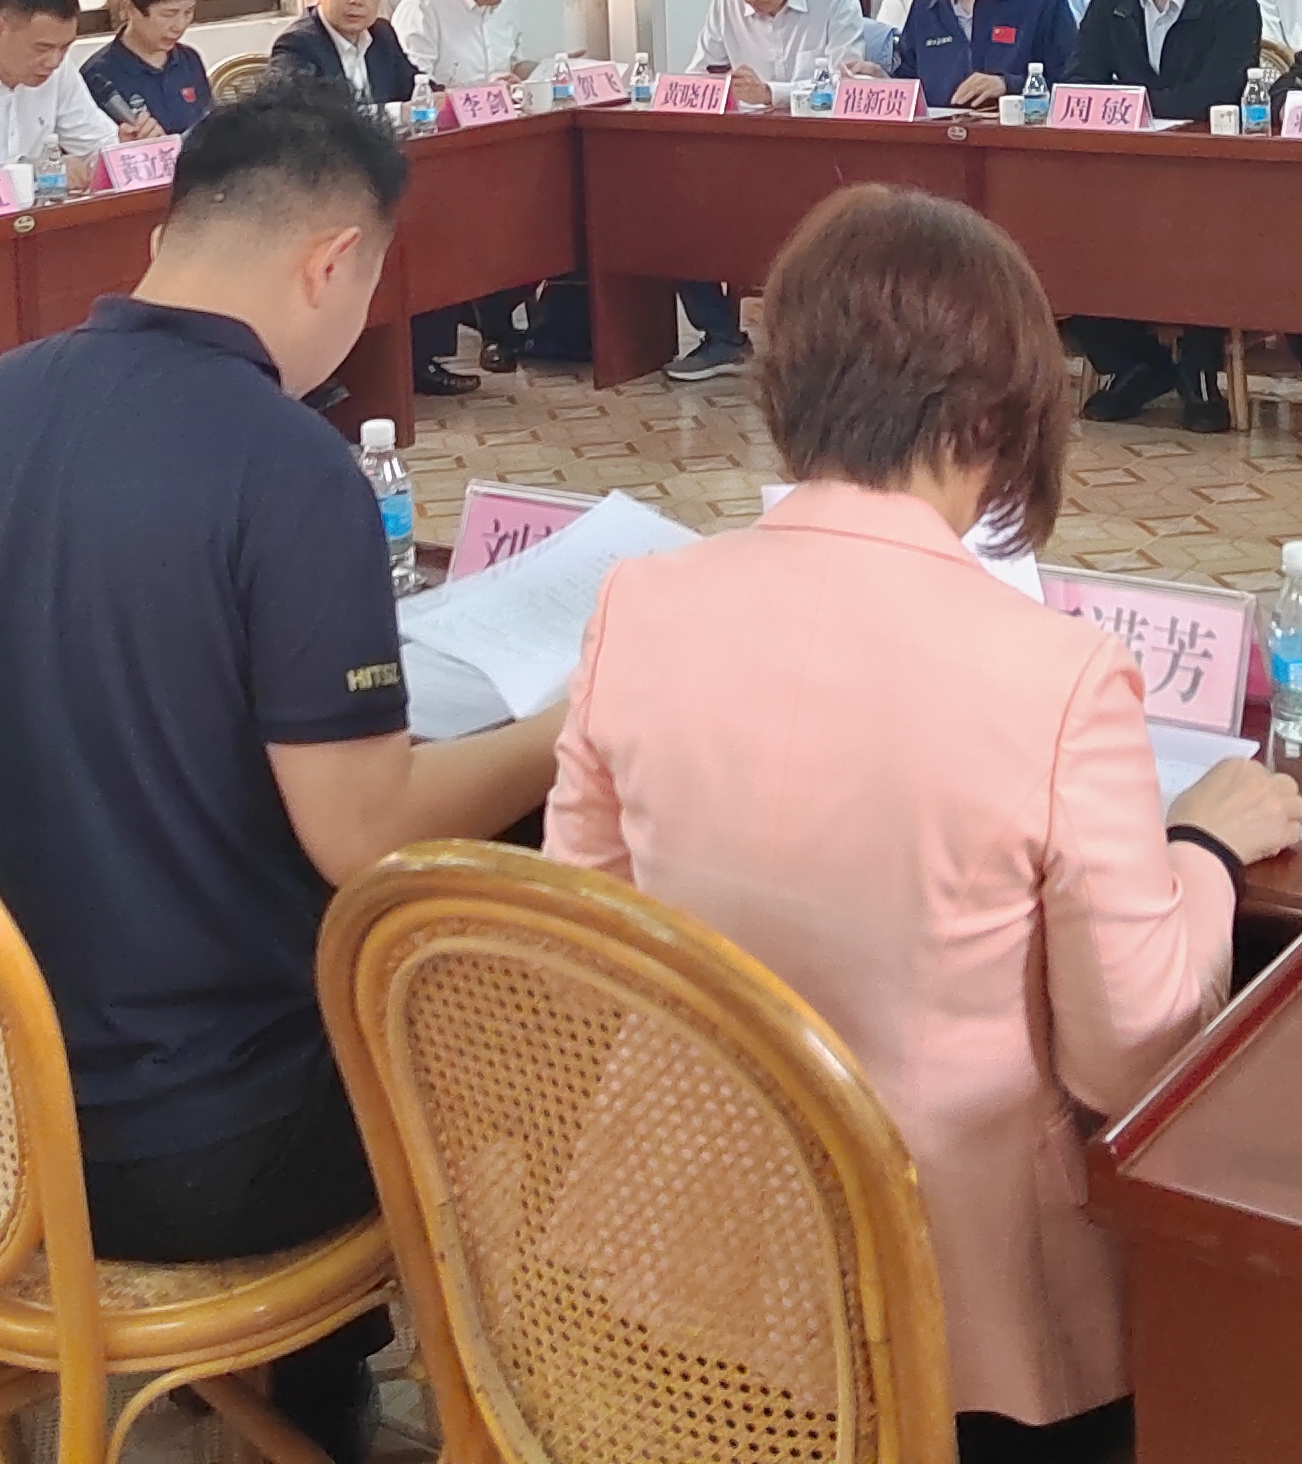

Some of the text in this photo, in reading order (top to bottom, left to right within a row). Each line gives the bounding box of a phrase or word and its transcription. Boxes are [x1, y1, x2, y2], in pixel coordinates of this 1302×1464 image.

[577, 72, 621, 100] 贺飞
[660, 81, 721, 111] 黄晓伟
[843, 87, 907, 116] 崔新贵
[1060, 95, 1132, 124] 周敏
